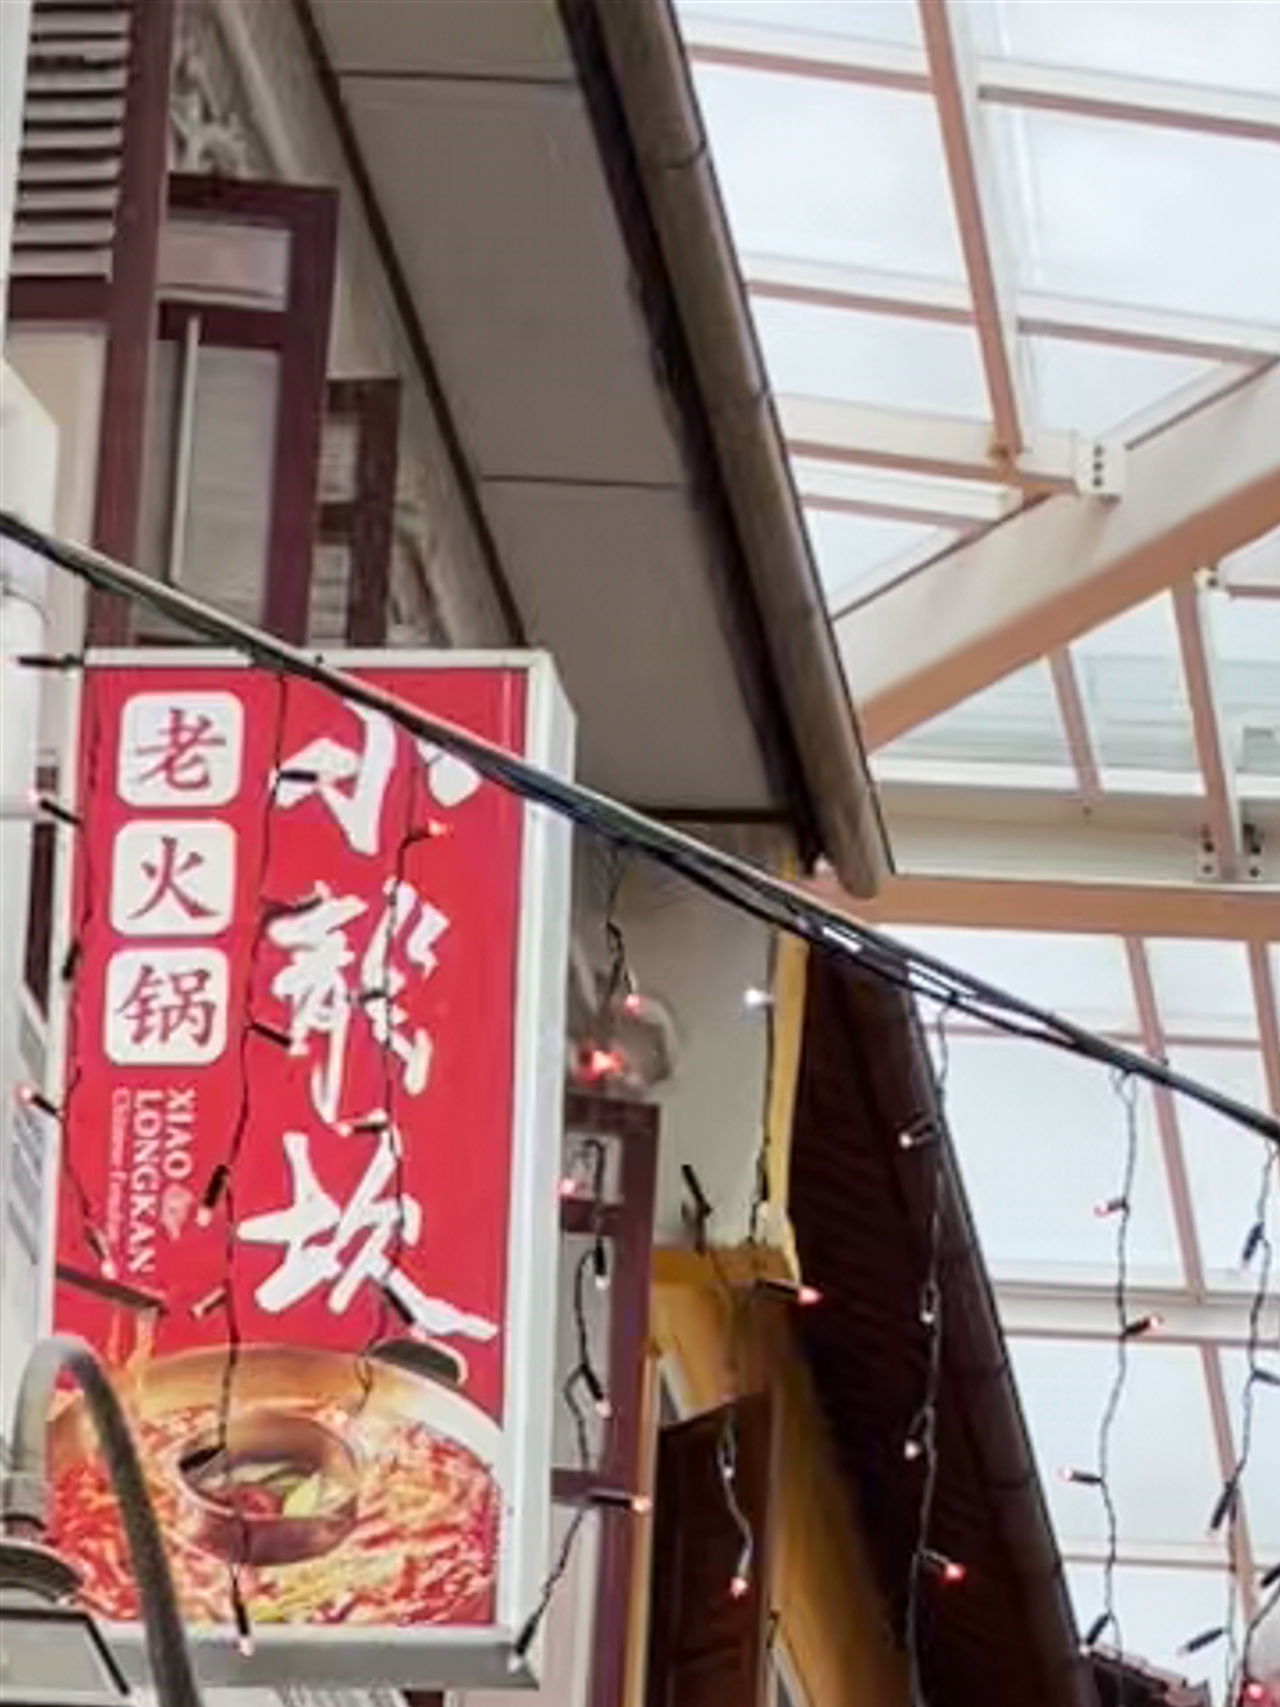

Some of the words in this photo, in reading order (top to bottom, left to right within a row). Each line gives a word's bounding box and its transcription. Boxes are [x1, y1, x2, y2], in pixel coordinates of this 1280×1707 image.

[116, 707, 227, 1050] 老火锅
[127, 1088, 165, 1273] LONGKAN
[164, 1088, 197, 1181] XIAO
